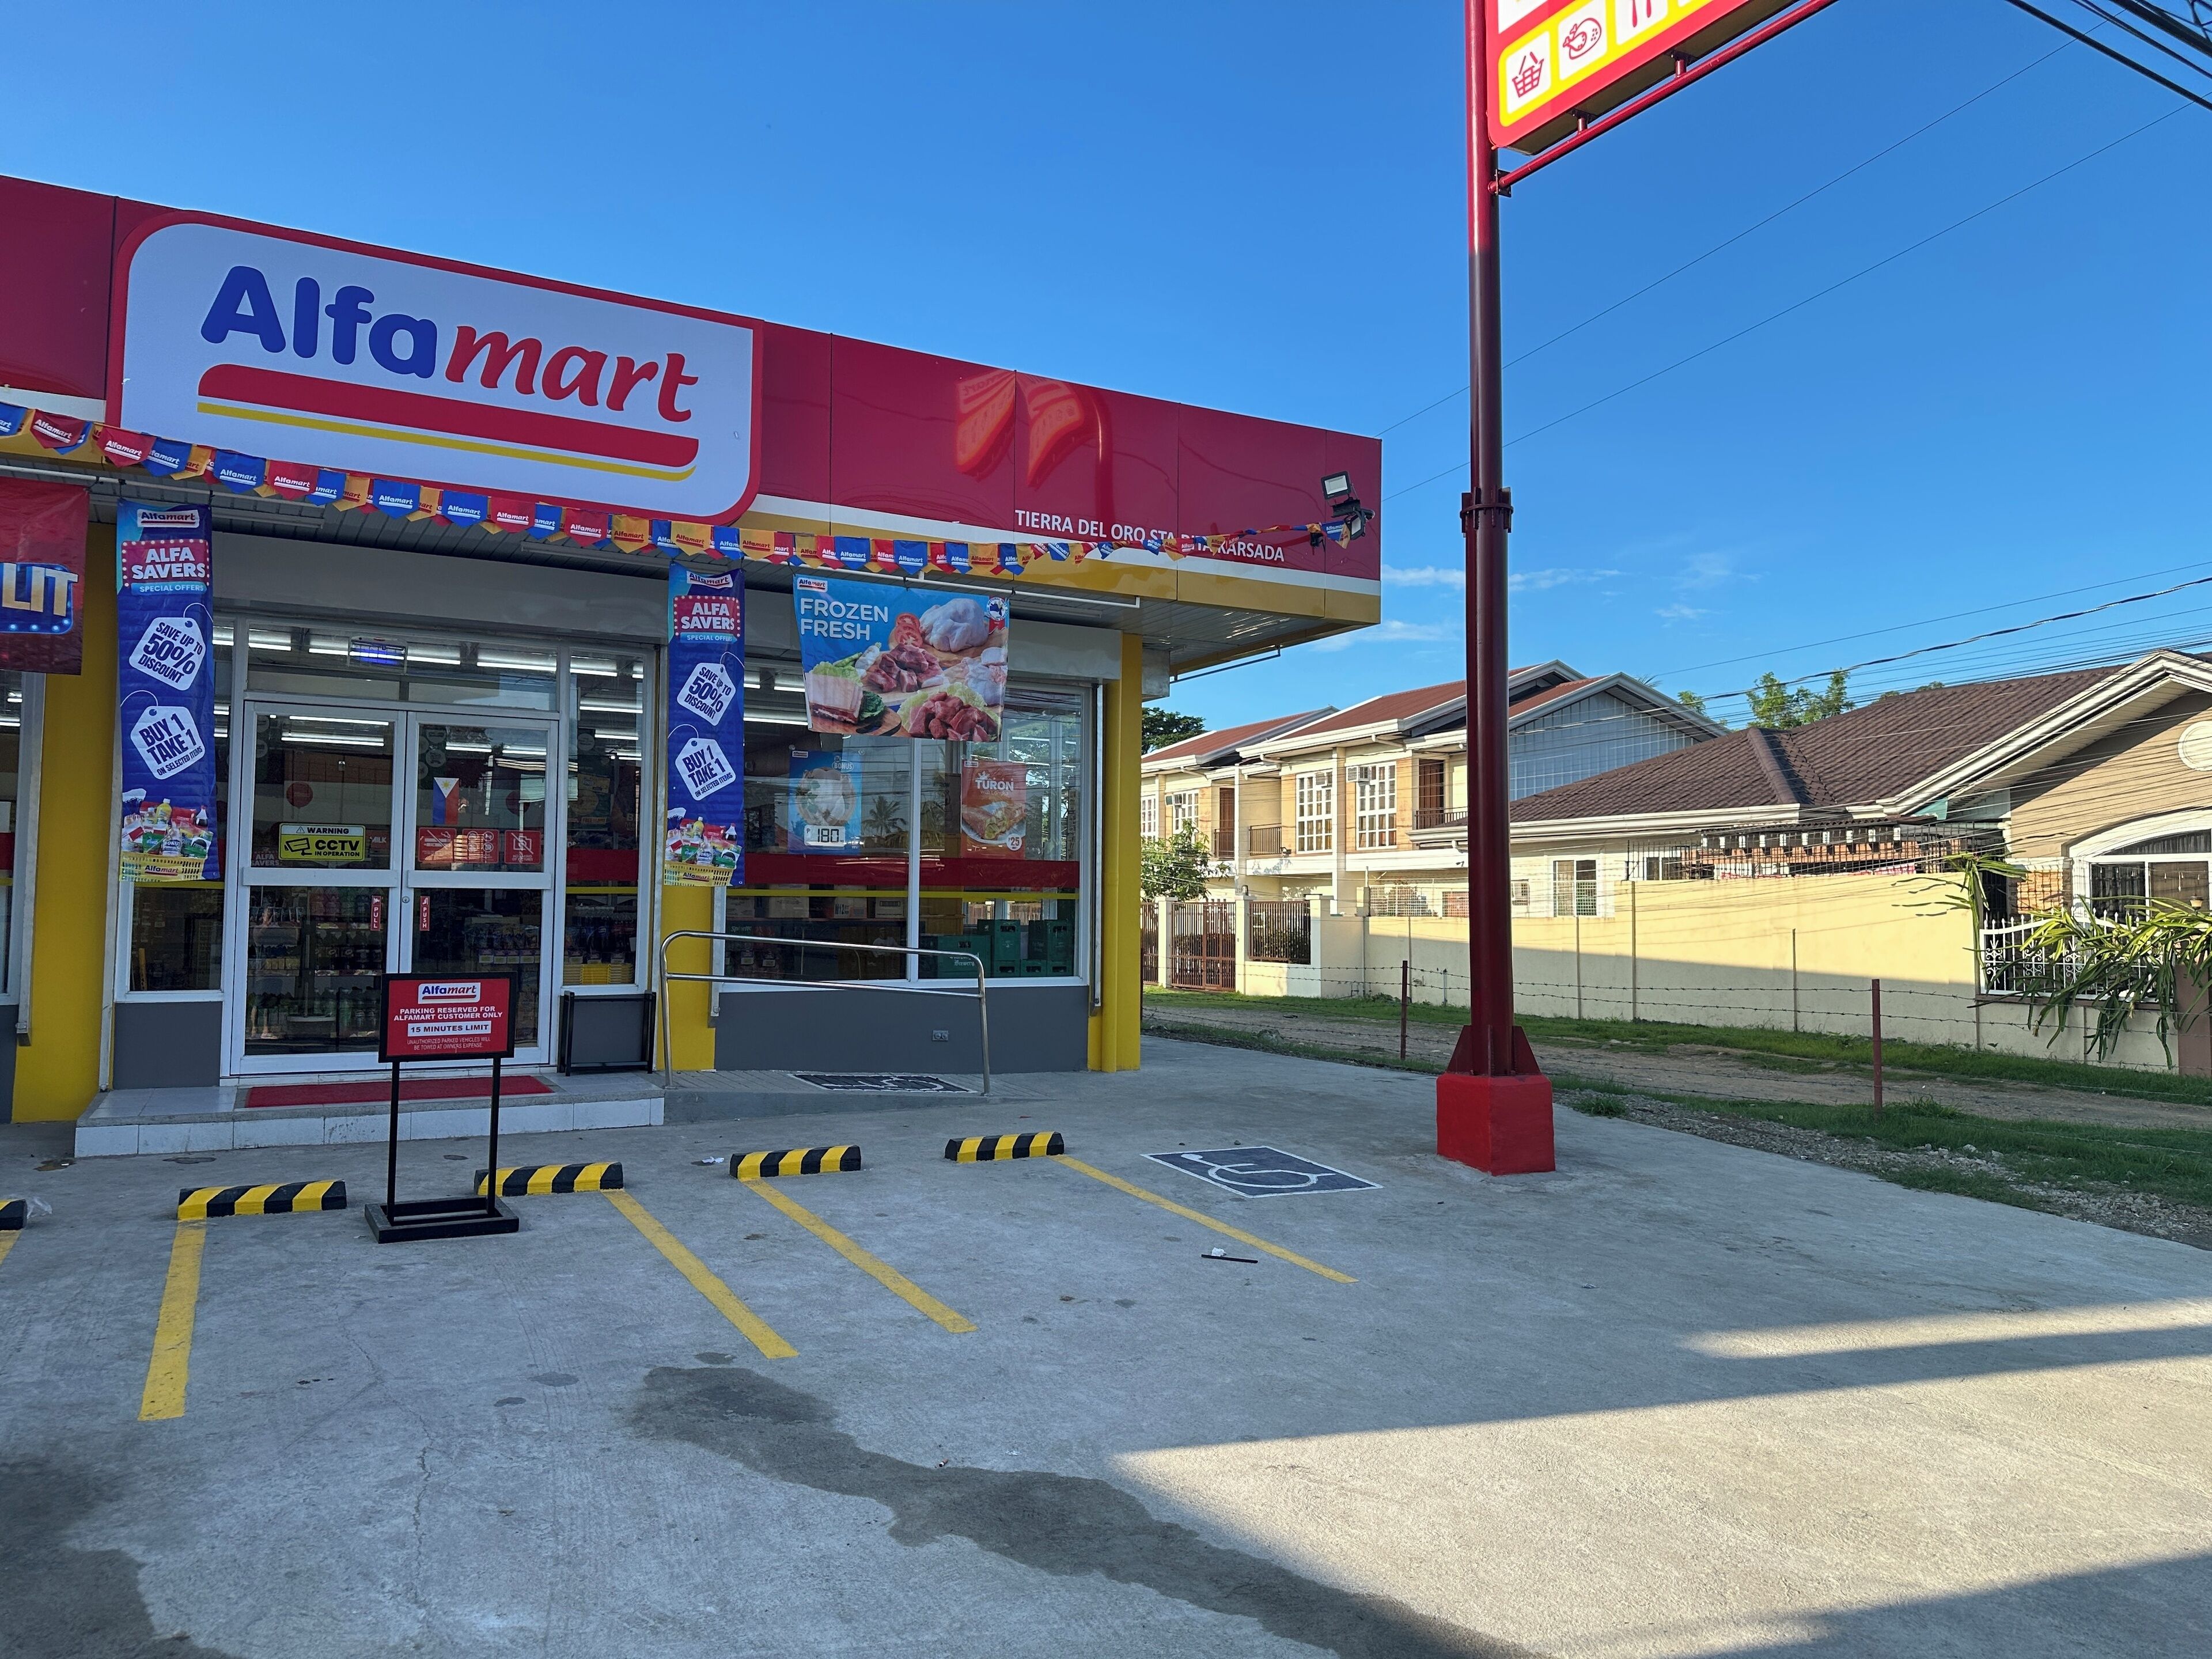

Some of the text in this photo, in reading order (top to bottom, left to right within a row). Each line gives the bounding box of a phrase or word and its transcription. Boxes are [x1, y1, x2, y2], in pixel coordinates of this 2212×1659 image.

[200, 266, 699, 422] Alfamart
[35, 419, 73, 439] Alfamart
[106, 440, 142, 456] Alfamart
[220, 469, 257, 482] Alfamart
[274, 476, 310, 487] Alfamart
[378, 495, 413, 505] Alfamart
[141, 512, 196, 521] Alfamart
[448, 505, 481, 516] Alfamart
[497, 512, 529, 521] Alfamart
[570, 524, 602, 534] Alfamart
[614, 531, 644, 539] Alfamart
[1015, 509, 1073, 533] TIERRA
[1078, 518, 1107, 538] DEL
[1111, 524, 1145, 542] ORO
[1218, 541, 1285, 562] KARSADA
[676, 533, 704, 544] Alfamart
[742, 540, 770, 548] Alfamart
[145, 547, 195, 563] ALFA
[899, 555, 923, 563] Alfamart
[131, 563, 206, 580] SAVERS
[689, 573, 729, 584] Alfamart
[139, 585, 173, 593] SPECIAL
[799, 578, 826, 588] Alfamart
[692, 603, 730, 616] ALFA
[800, 597, 888, 623] FROZEN
[681, 616, 735, 630] SAVERS
[800, 619, 870, 641] FRESH
[156, 622, 203, 656] SAVE UP TO
[143, 633, 196, 675] 50%
[138, 654, 184, 683] DISCOUNT
[699, 666, 718, 684] SAVE
[722, 684, 732, 696] TO
[688, 676, 724, 713] 50%
[684, 693, 716, 719] DISCOUNT
[138, 713, 185, 747] BUY 1
[146, 729, 196, 766] TAKE 1
[157, 746, 203, 776] ON SELECTED ITEMS
[682, 745, 714, 772] BUY 1
[687, 757, 726, 789] TAKE 1
[834, 762, 853, 770] BONUS
[701, 779, 720, 794] SELECTED
[719, 772, 733, 784] ITEMS
[975, 779, 1014, 791] TURON
[306, 827, 349, 835] WARNING
[817, 828, 839, 843] 180
[315, 839, 360, 851] CCTV
[145, 865, 179, 873] Alfamart
[422, 985, 476, 995] Alfamart
